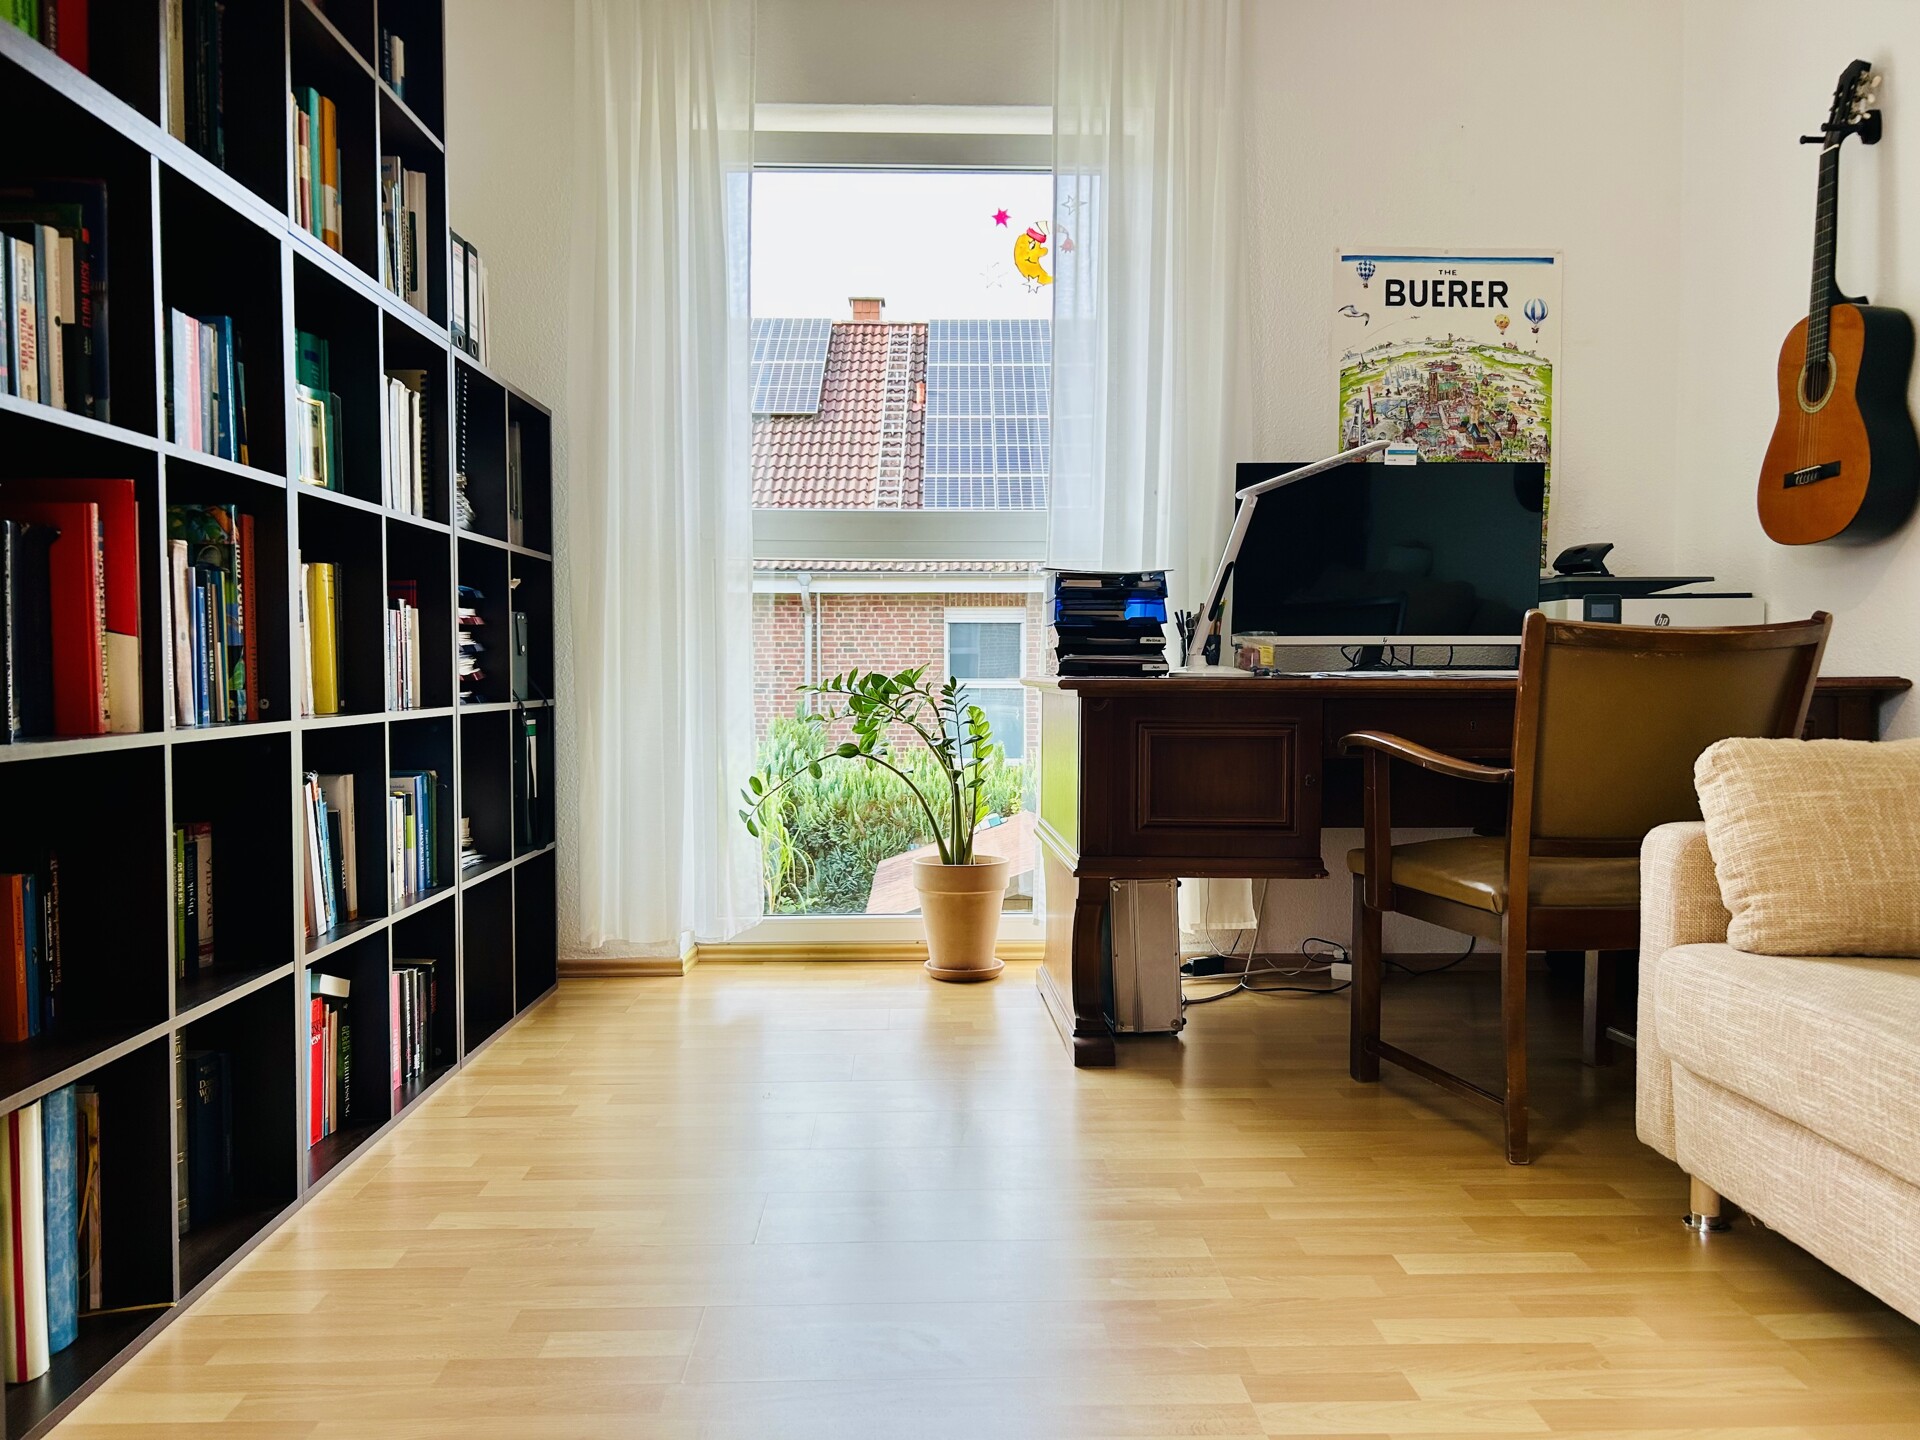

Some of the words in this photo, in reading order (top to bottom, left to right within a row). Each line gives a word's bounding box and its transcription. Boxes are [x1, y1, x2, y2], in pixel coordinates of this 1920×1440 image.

[80, 260, 91, 294] MUSK
[1385, 279, 1509, 308] BUERER
[82, 297, 92, 329] ELON
[19, 308, 28, 372] SEBASTIAN
[27, 322, 35, 361] FITZEK
[1656, 614, 1669, 626] hp
[187, 882, 195, 916] Physik
